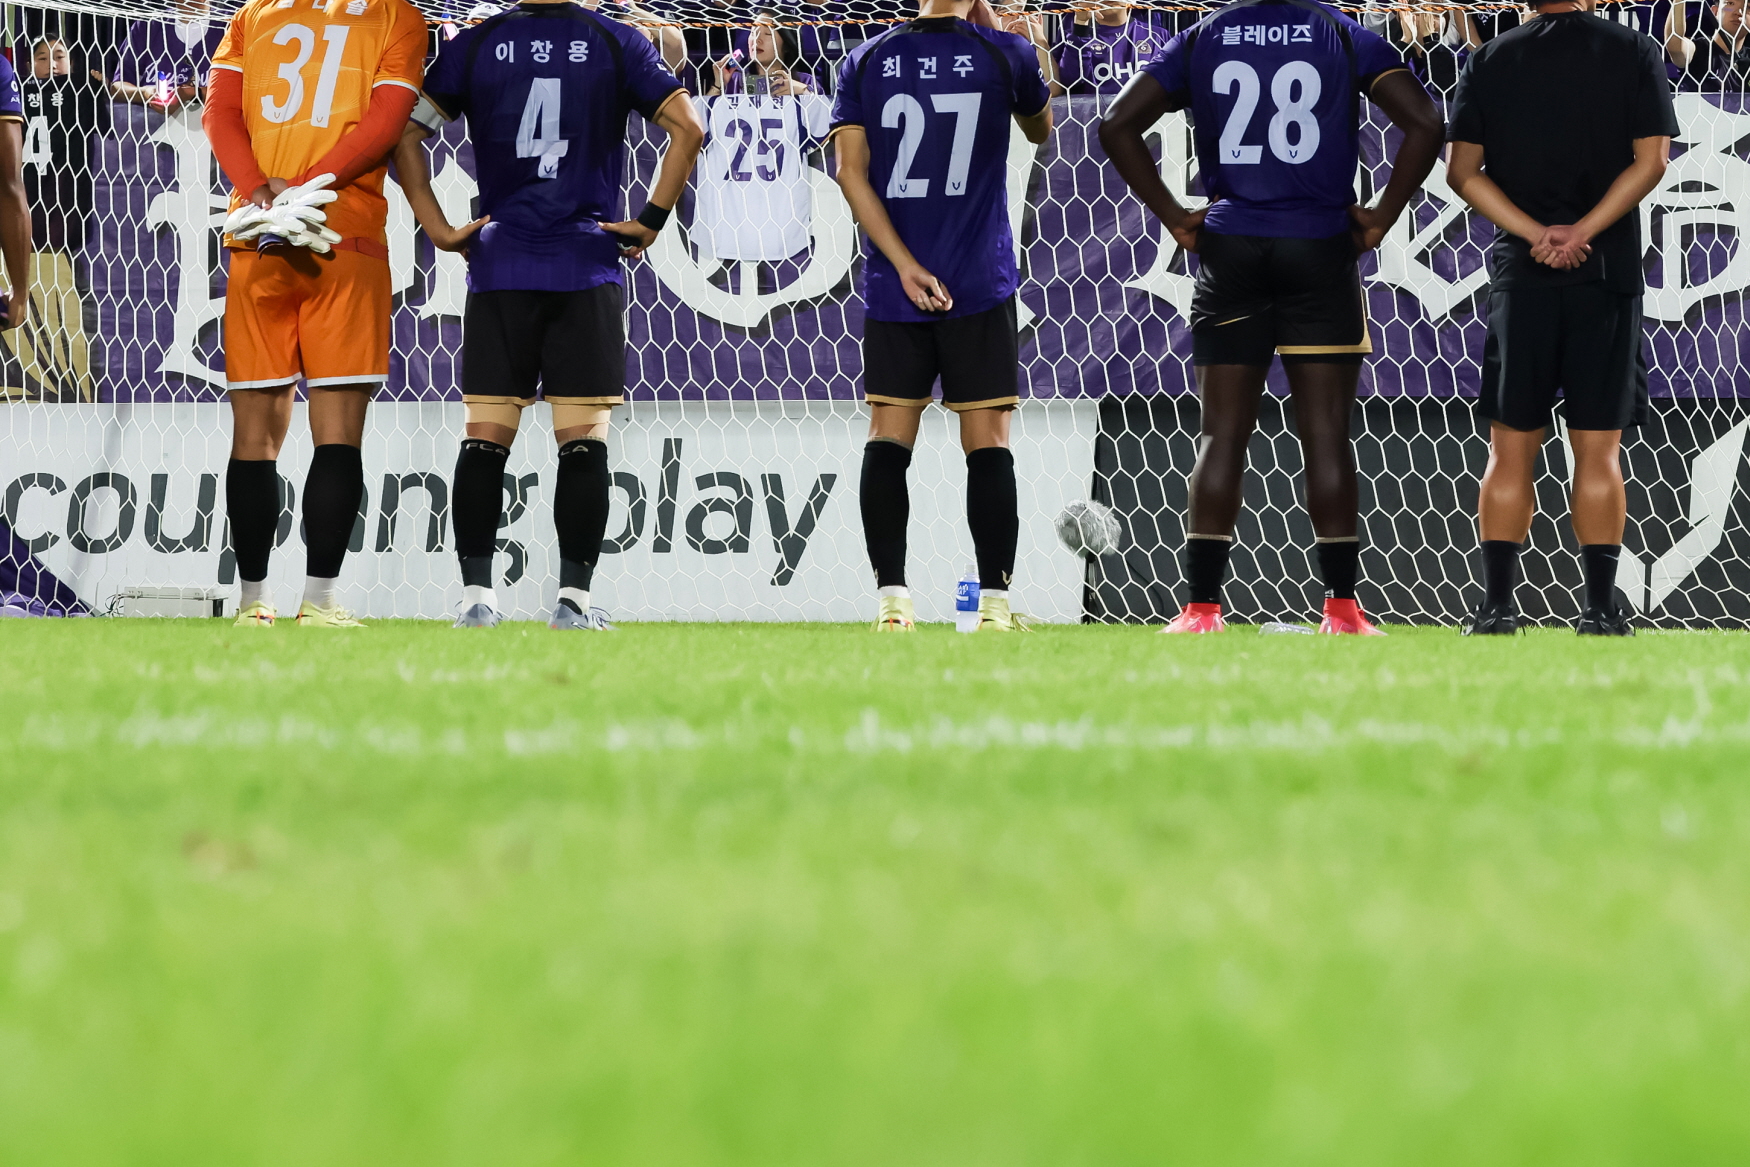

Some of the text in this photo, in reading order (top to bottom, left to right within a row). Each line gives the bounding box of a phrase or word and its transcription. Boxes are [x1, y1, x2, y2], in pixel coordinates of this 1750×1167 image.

[495, 40, 590, 65] 이창용
[1221, 22, 1313, 47] 블레이즈
[260, 23, 350, 129] 31
[882, 54, 975, 81] 최건주
[516, 77, 570, 179] 4
[1212, 60, 1322, 165] 28
[21, 115, 54, 176] 4
[723, 118, 784, 182] 25
[881, 92, 983, 199] 27
